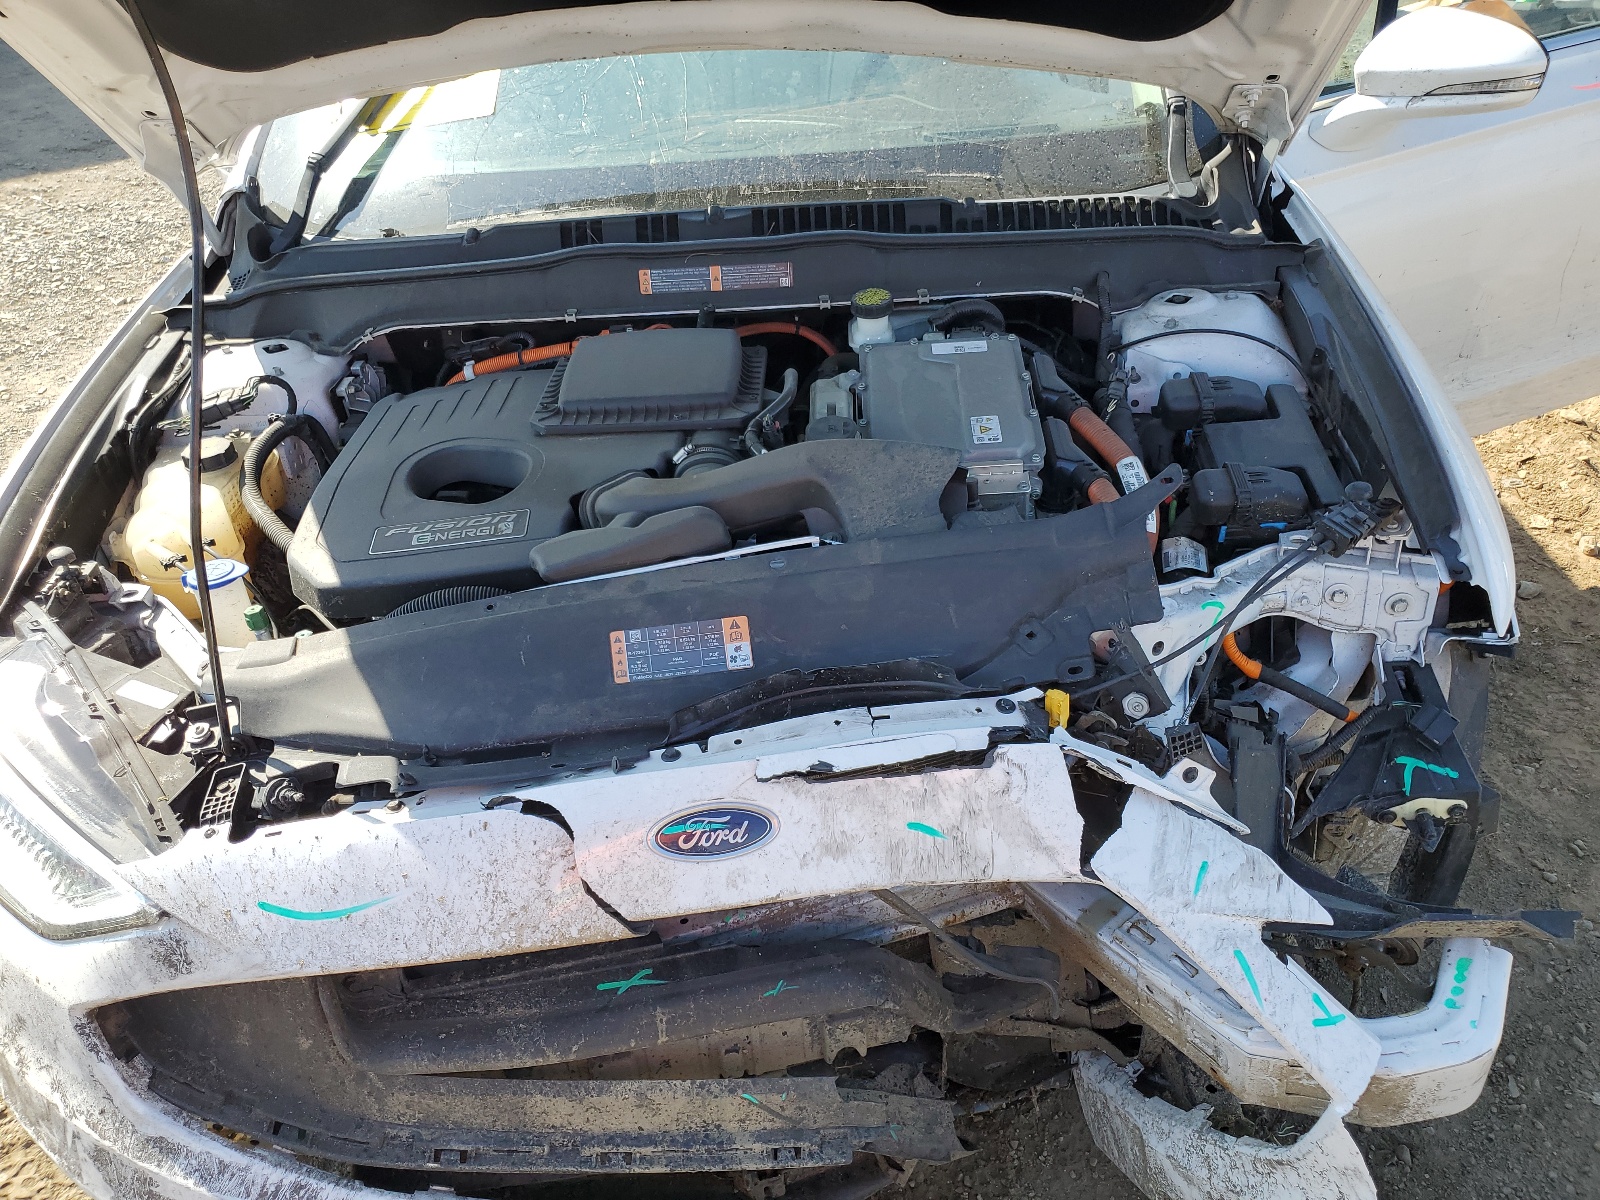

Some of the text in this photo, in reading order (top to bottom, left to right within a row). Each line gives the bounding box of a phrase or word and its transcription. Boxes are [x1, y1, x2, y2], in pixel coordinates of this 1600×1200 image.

[385, 513, 518, 537] FUSION
[411, 525, 496, 546] ENERGI
[678, 815, 749, 850] Ford
